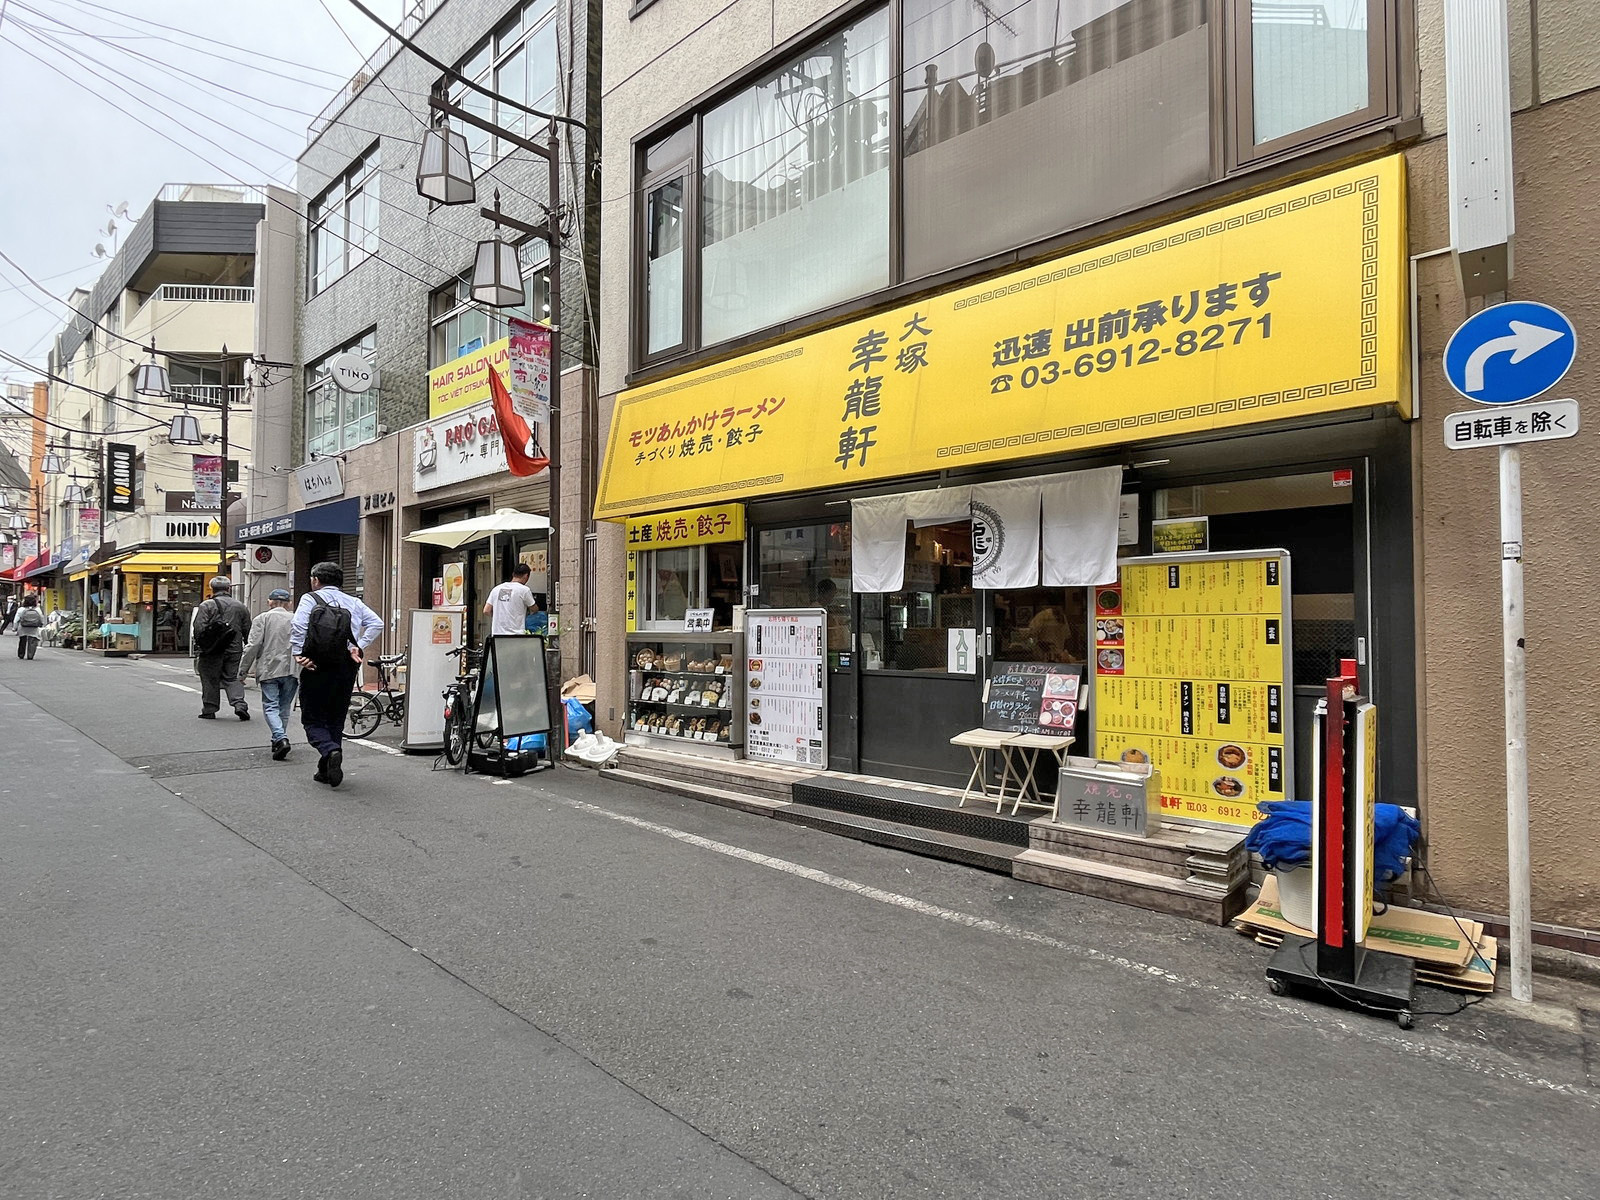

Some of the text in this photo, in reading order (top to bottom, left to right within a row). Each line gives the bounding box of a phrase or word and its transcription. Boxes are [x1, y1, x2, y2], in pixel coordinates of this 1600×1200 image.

[991, 271, 1282, 369] 迅速 出前承ります
[894, 312, 933, 374] 大塚
[1020, 312, 1272, 389] 03-6912-8271
[339, 368, 369, 380] TINO
[432, 371, 454, 391] HAIR
[457, 355, 491, 380] SALON
[495, 349, 510, 364] UN
[834, 329, 889, 470] 幸龍軒
[628, 396, 786, 447] モツあんかけラーメン
[1455, 410, 1567, 442] 自転車を除く
[480, 440, 505, 459] 専門
[628, 513, 731, 543] 土産 焼売・餃子
[627, 552, 635, 620] 中華弁当
[687, 618, 710, 628] 営業中
[1073, 798, 1141, 830] 幸龍軒
